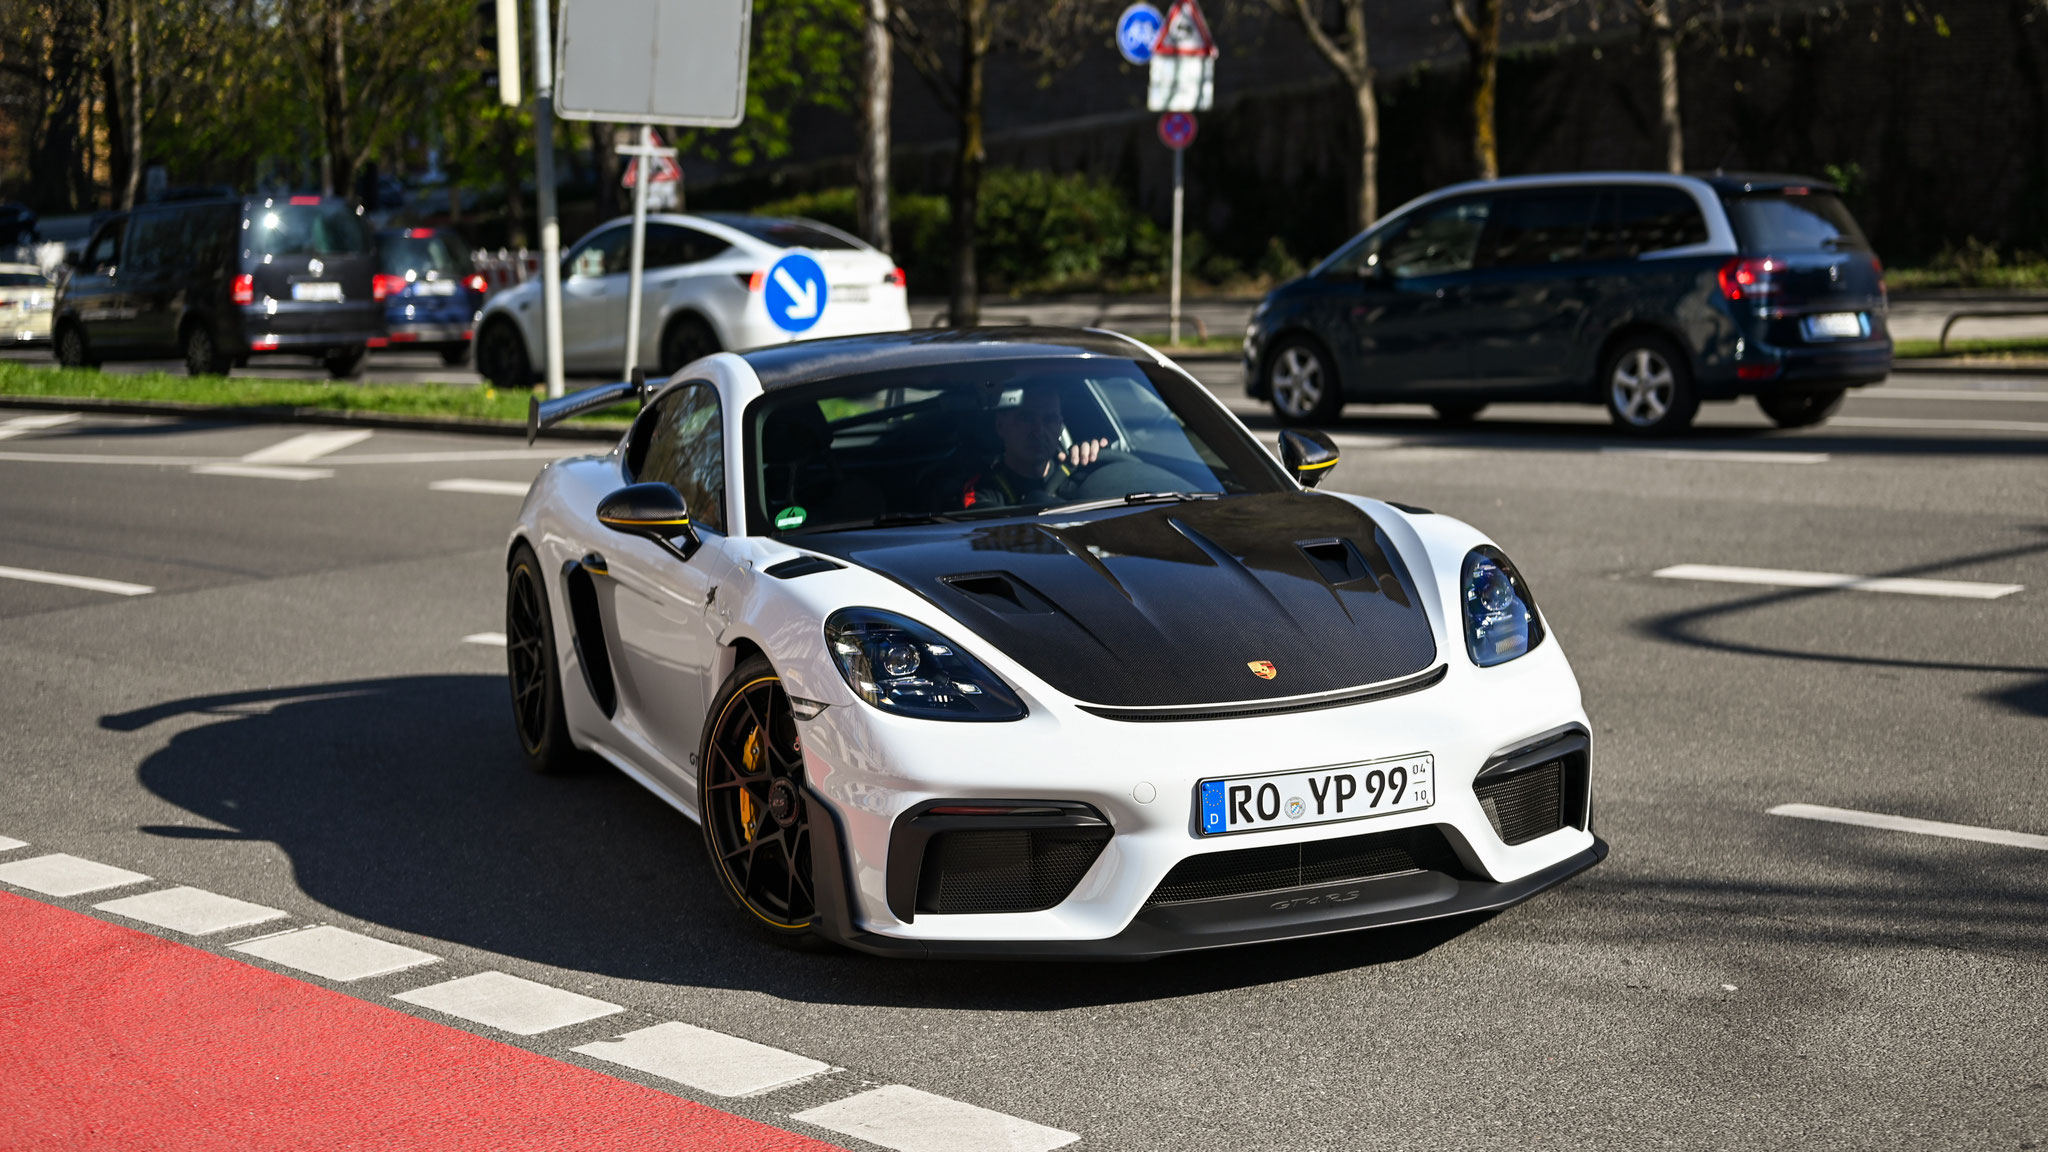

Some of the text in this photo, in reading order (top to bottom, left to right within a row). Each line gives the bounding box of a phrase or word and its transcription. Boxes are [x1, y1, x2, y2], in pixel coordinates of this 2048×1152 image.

[787, 506, 796, 518] 4
[1412, 763, 1426, 775] 04
[1229, 782, 1281, 825] RO
[1308, 774, 1357, 815] YP
[1365, 766, 1408, 808] 99
[1414, 789, 1427, 801] 10
[1210, 813, 1219, 825] D
